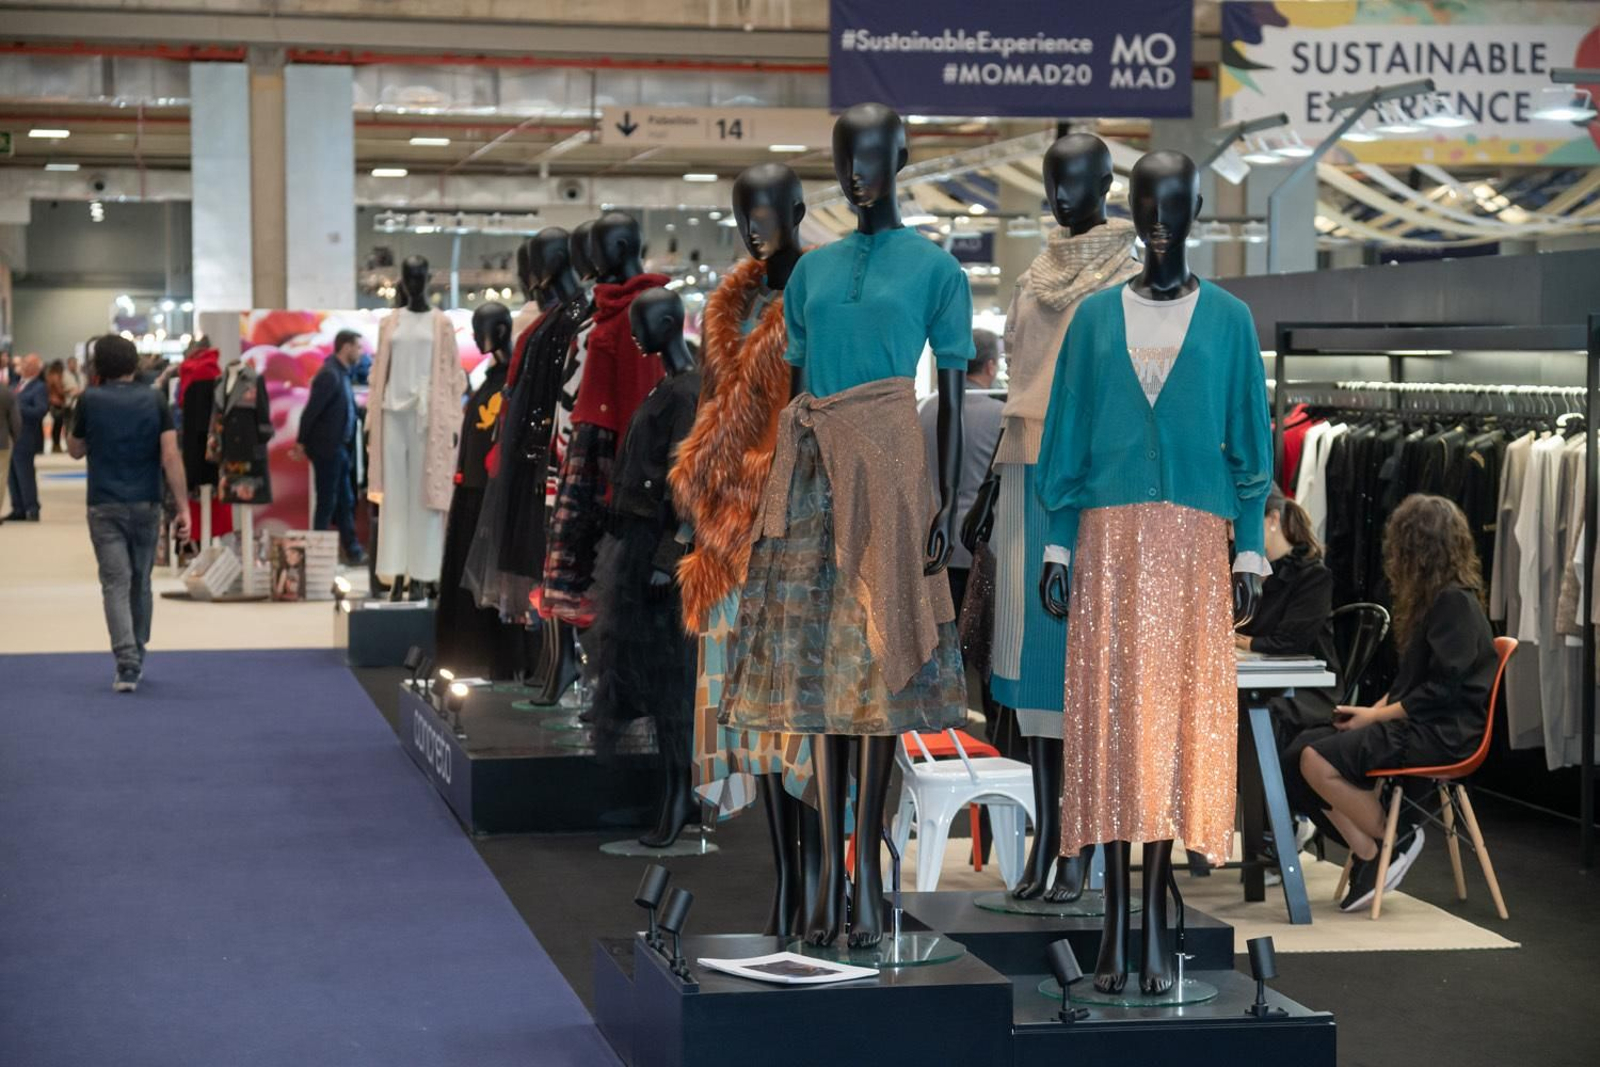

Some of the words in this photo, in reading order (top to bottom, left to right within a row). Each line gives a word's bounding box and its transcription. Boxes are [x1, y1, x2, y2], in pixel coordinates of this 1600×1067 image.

[841, 29, 1093, 57] #SustainableExperience
[1111, 32, 1176, 66] MO
[1292, 42, 1547, 75] SUSTAINABLE
[943, 63, 1092, 85] #MOMAD20
[1110, 67, 1176, 89] MAD
[716, 118, 743, 140] 14
